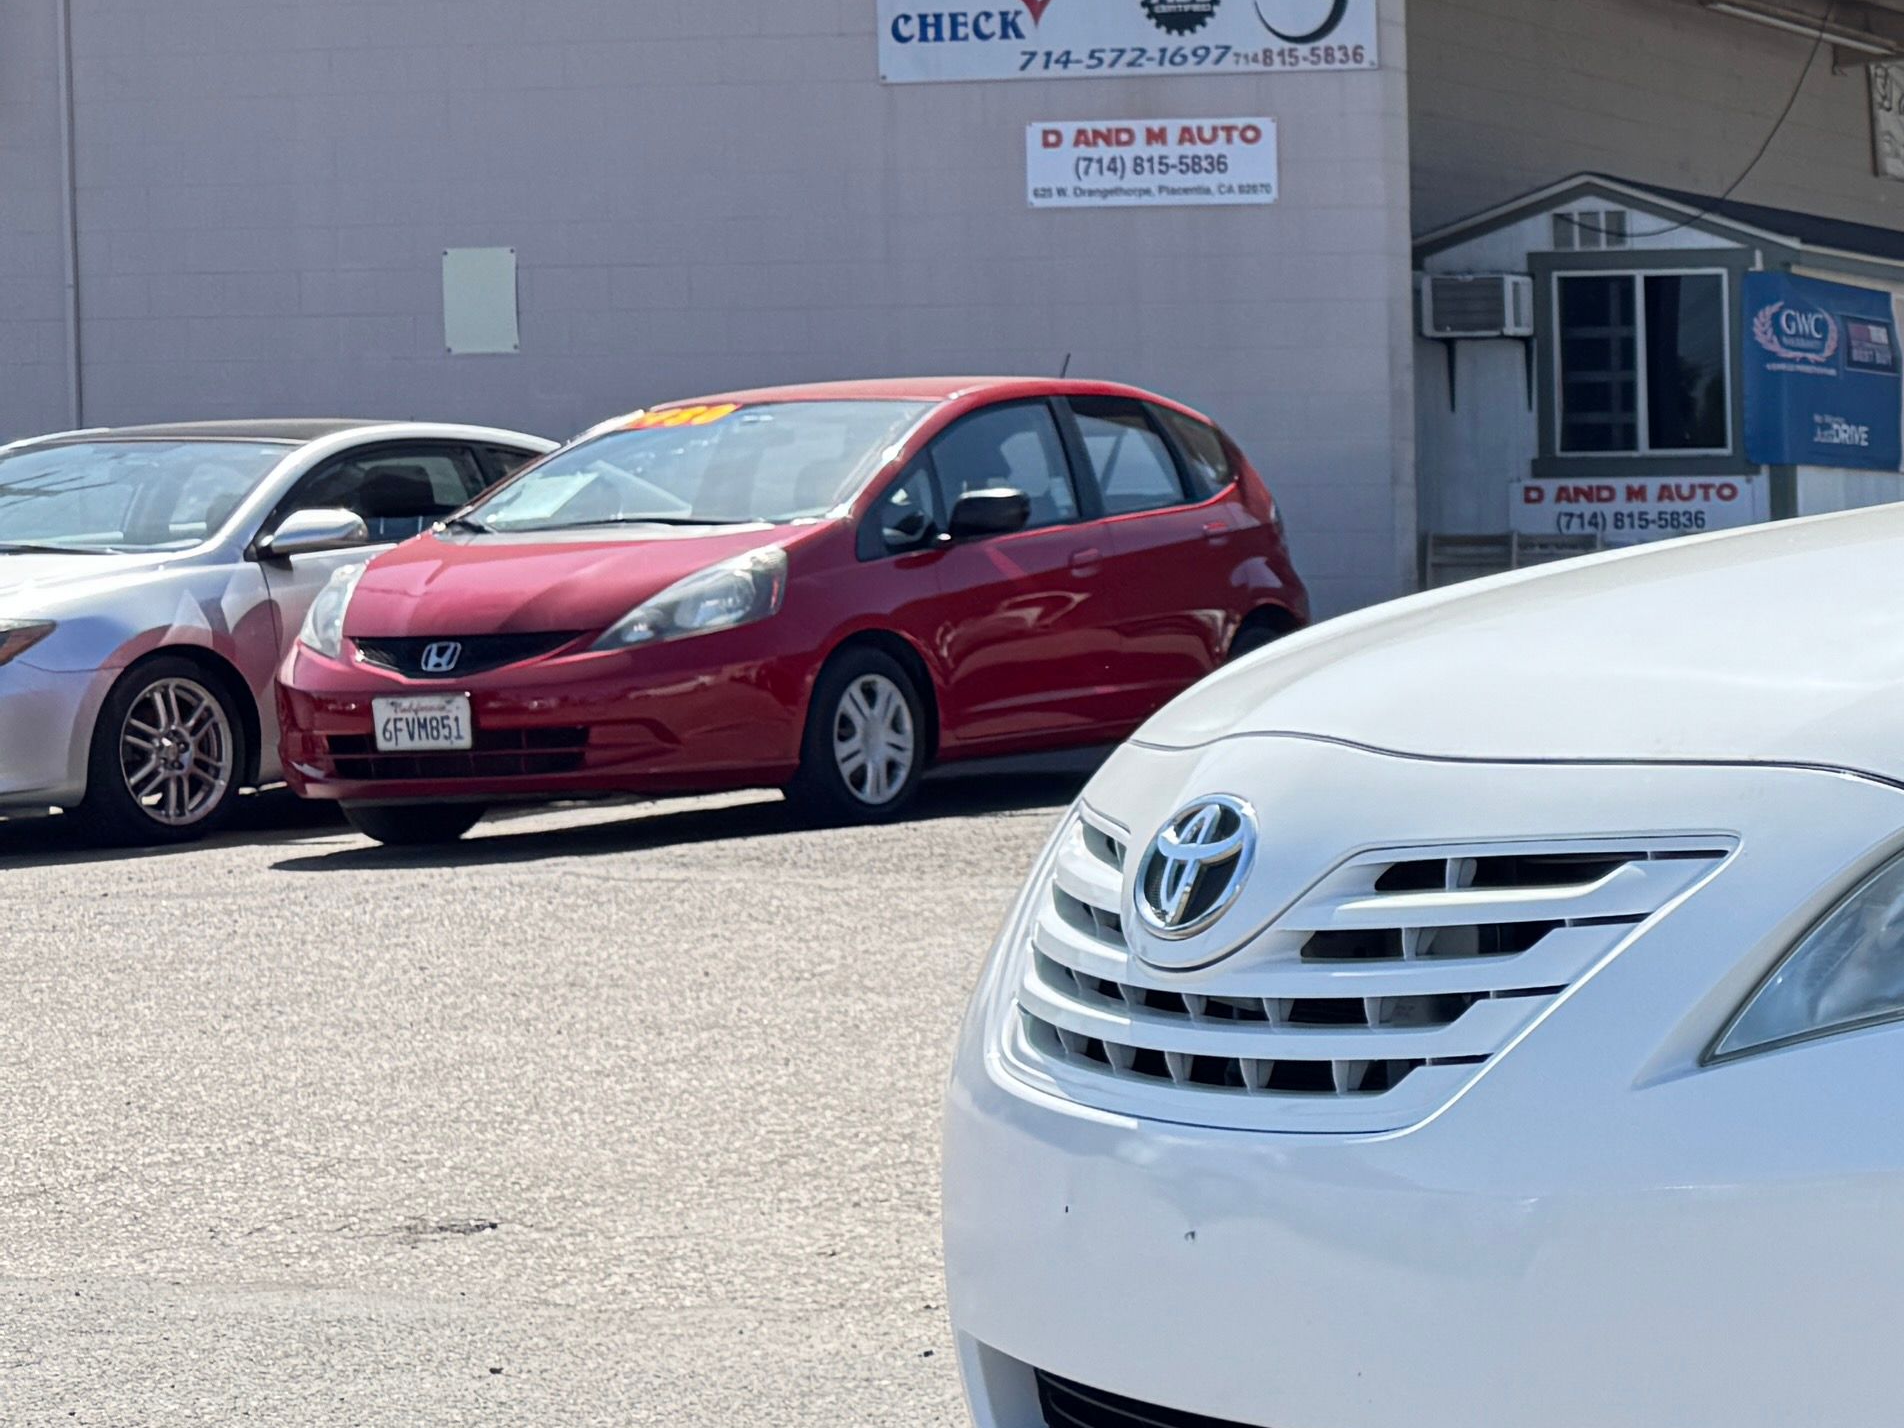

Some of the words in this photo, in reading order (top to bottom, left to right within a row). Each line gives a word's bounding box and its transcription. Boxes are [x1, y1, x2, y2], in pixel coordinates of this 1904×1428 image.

[891, 9, 1026, 44] CHECK
[1019, 44, 1233, 71] 714-572-1697
[1875, 65, 1893, 112] D
[1041, 128, 1064, 149] D
[1072, 127, 1136, 148] AND
[1144, 125, 1169, 147] M
[1177, 124, 1263, 146] AUTO
[1074, 155, 1126, 181] (714)
[1132, 154, 1229, 176] 815-5836
[1217, 183, 1236, 196] CA
[1780, 309, 1824, 339] GWC
[1523, 485, 1545, 504] D
[1555, 484, 1617, 504] AND
[1625, 483, 1647, 503] M
[1657, 482, 1739, 503] AUTO
[1556, 511, 1607, 533] (714)
[1613, 510, 1706, 530] 815-5836
[382, 714, 465, 747] 6FVM851
